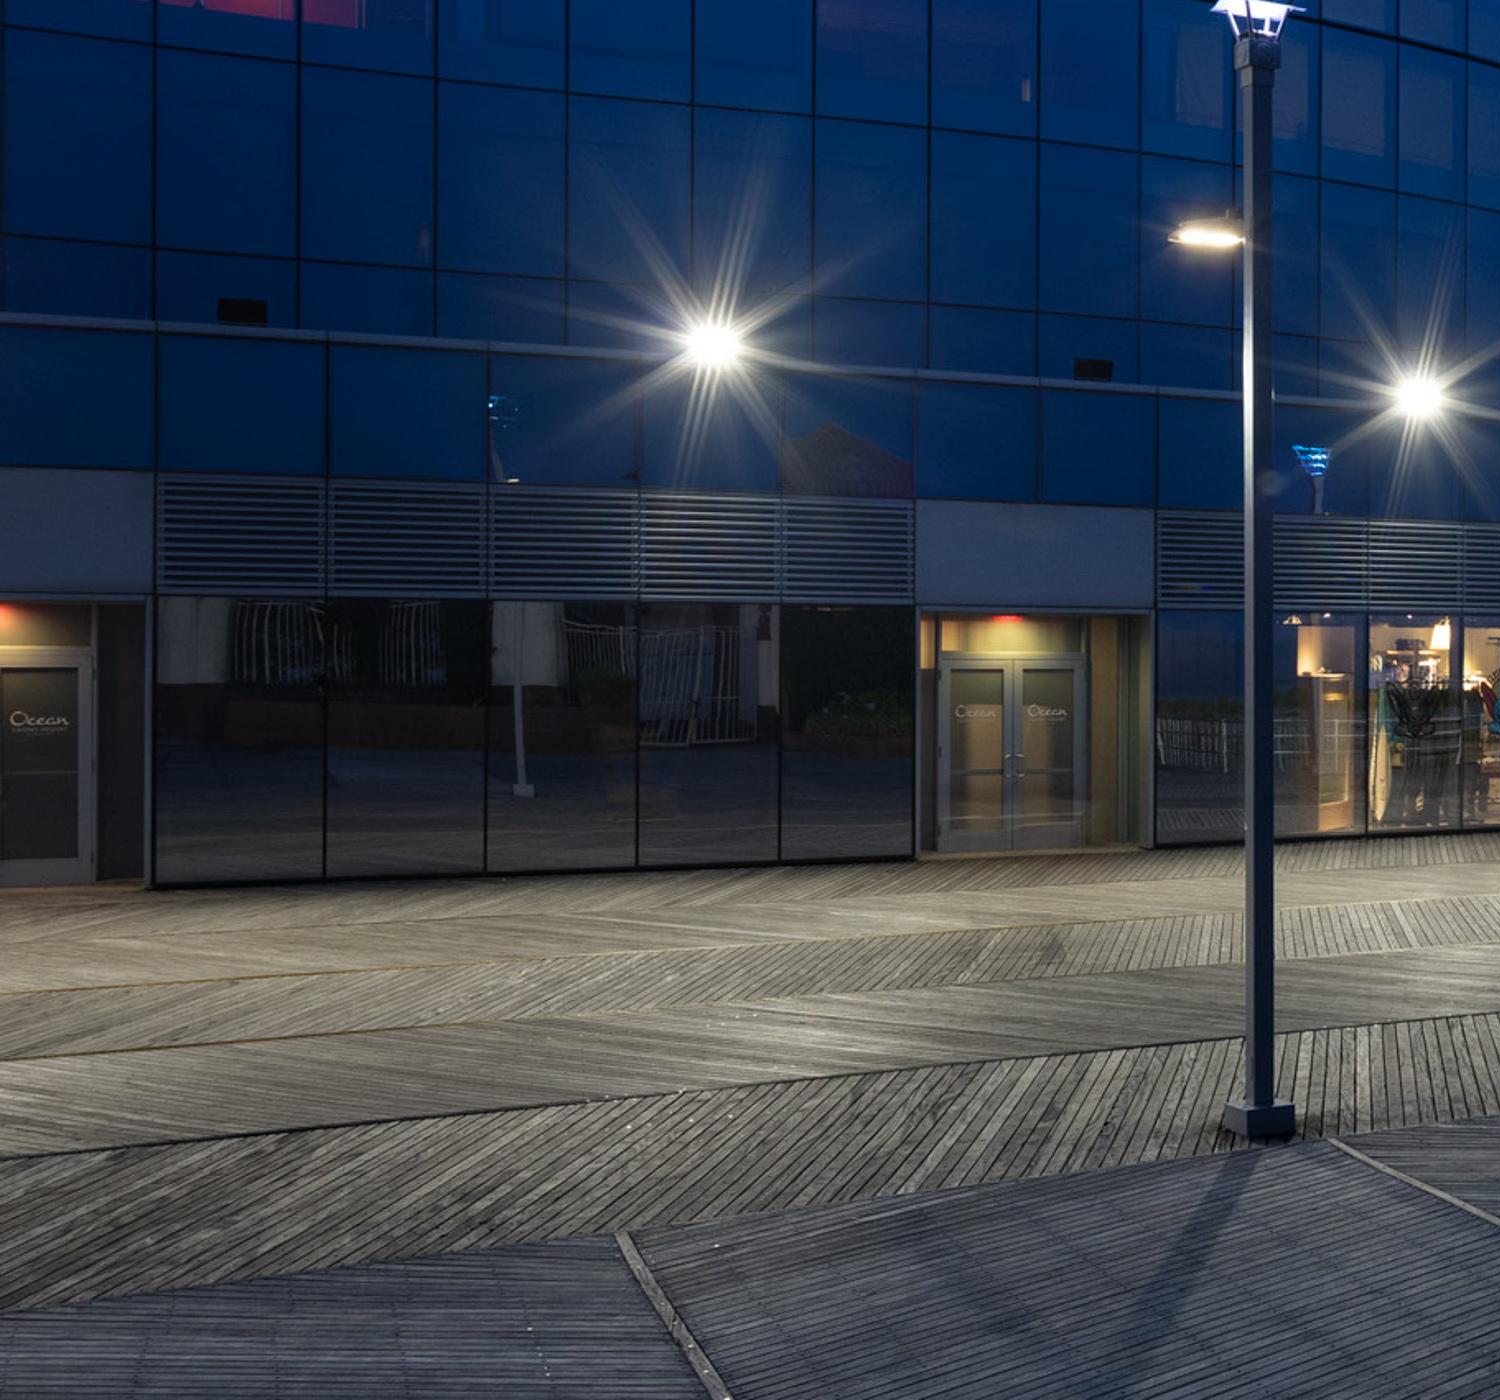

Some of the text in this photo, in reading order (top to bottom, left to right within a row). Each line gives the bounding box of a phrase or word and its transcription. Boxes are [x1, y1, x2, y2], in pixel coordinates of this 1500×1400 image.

[955, 704, 996, 718] Ocean
[1027, 704, 1068, 717] Ocean
[9, 710, 70, 727] Ocean
